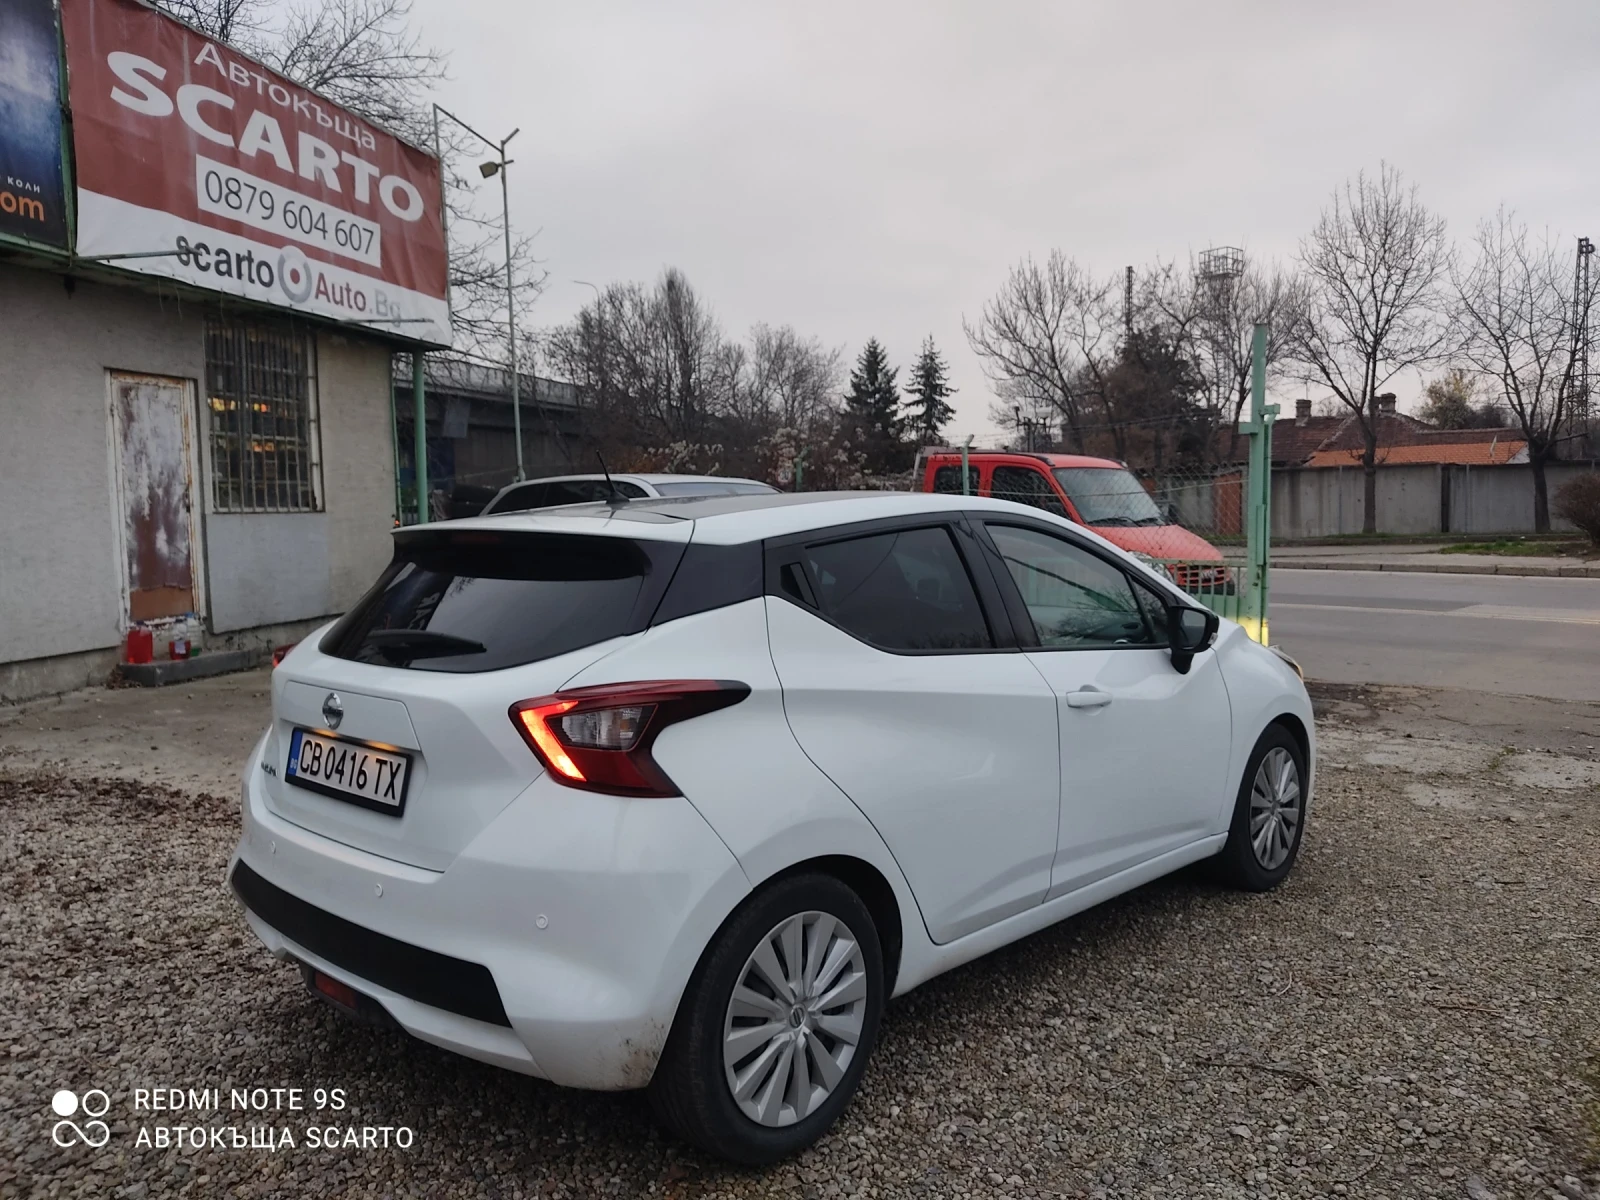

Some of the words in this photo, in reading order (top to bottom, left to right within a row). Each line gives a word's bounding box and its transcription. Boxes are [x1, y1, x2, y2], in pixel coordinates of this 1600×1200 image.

[107, 51, 424, 222] SCARTO
[205, 170, 275, 221] 0879
[283, 199, 328, 241] 604
[335, 219, 374, 255] 607
[176, 235, 275, 288] scarto
